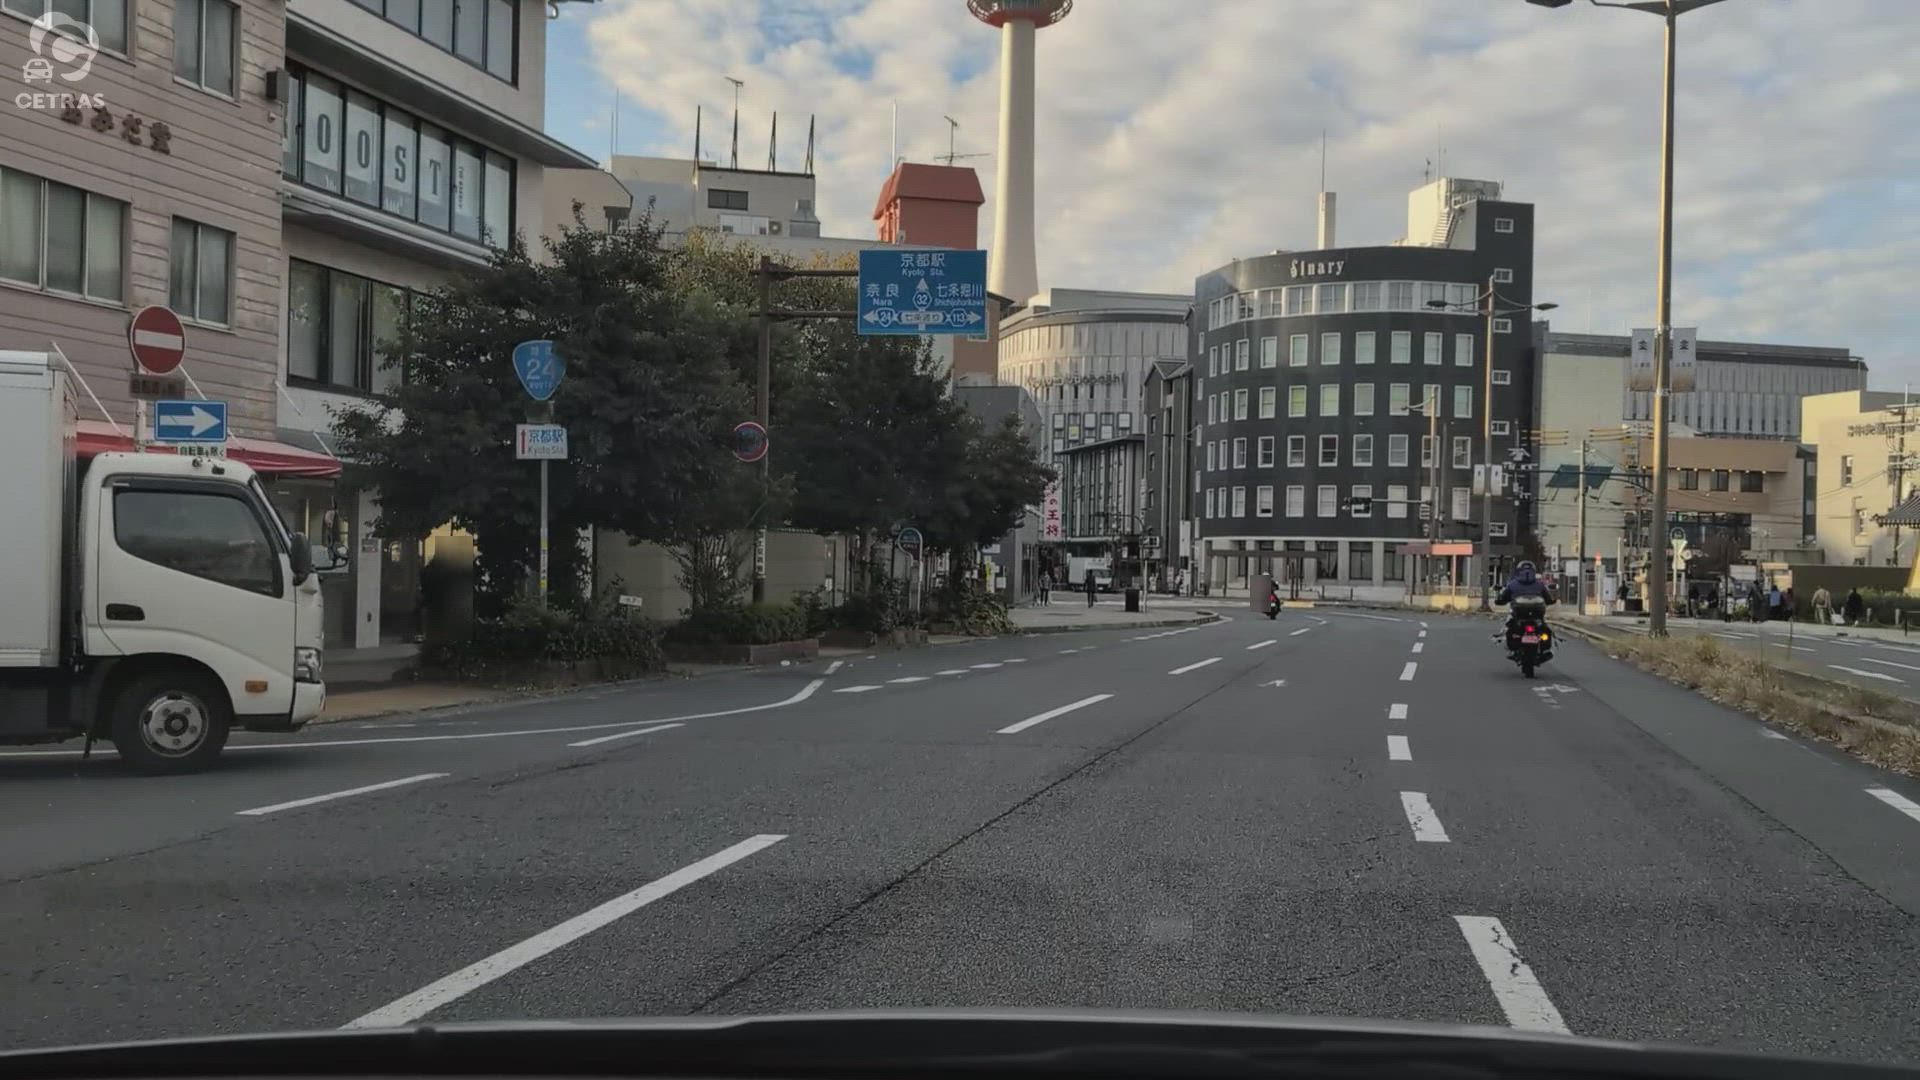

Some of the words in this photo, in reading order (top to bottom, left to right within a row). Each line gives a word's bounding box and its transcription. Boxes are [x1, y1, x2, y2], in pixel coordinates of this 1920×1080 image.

[900, 253, 945, 267] 京都駅
[902, 268, 925, 277] Kyoto
[866, 283, 899, 297] 奈良
[936, 283, 983, 297] 七条堀川
[873, 298, 893, 306] Nara
[917, 295, 927, 304] 32
[880, 312, 891, 321] 24
[527, 360, 556, 380] 24
[529, 429, 563, 443] 京都駅
[529, 446, 550, 457] Kyoto
